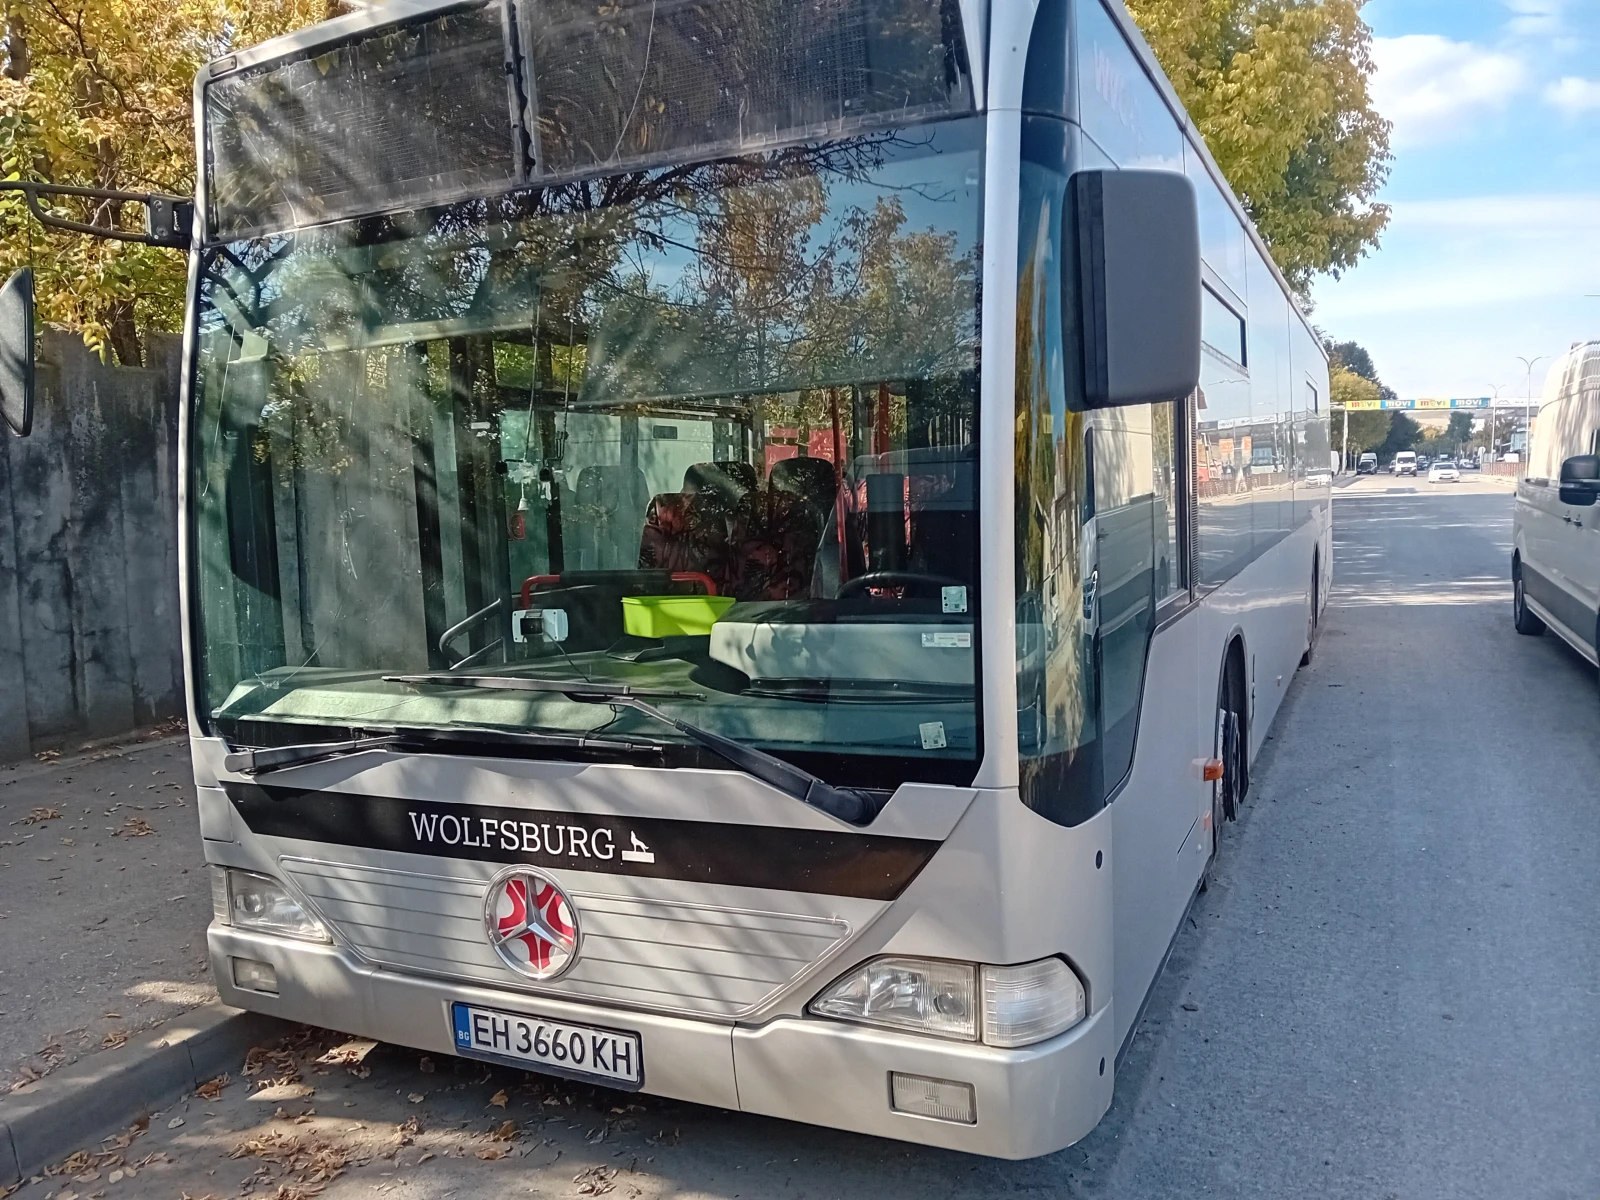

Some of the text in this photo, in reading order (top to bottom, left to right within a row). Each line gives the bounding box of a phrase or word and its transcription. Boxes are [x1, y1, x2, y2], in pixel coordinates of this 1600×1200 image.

[408, 811, 616, 860] WOLFSBURG
[458, 1030, 470, 1041] BG
[473, 1013, 632, 1076] EH 3660 KH
